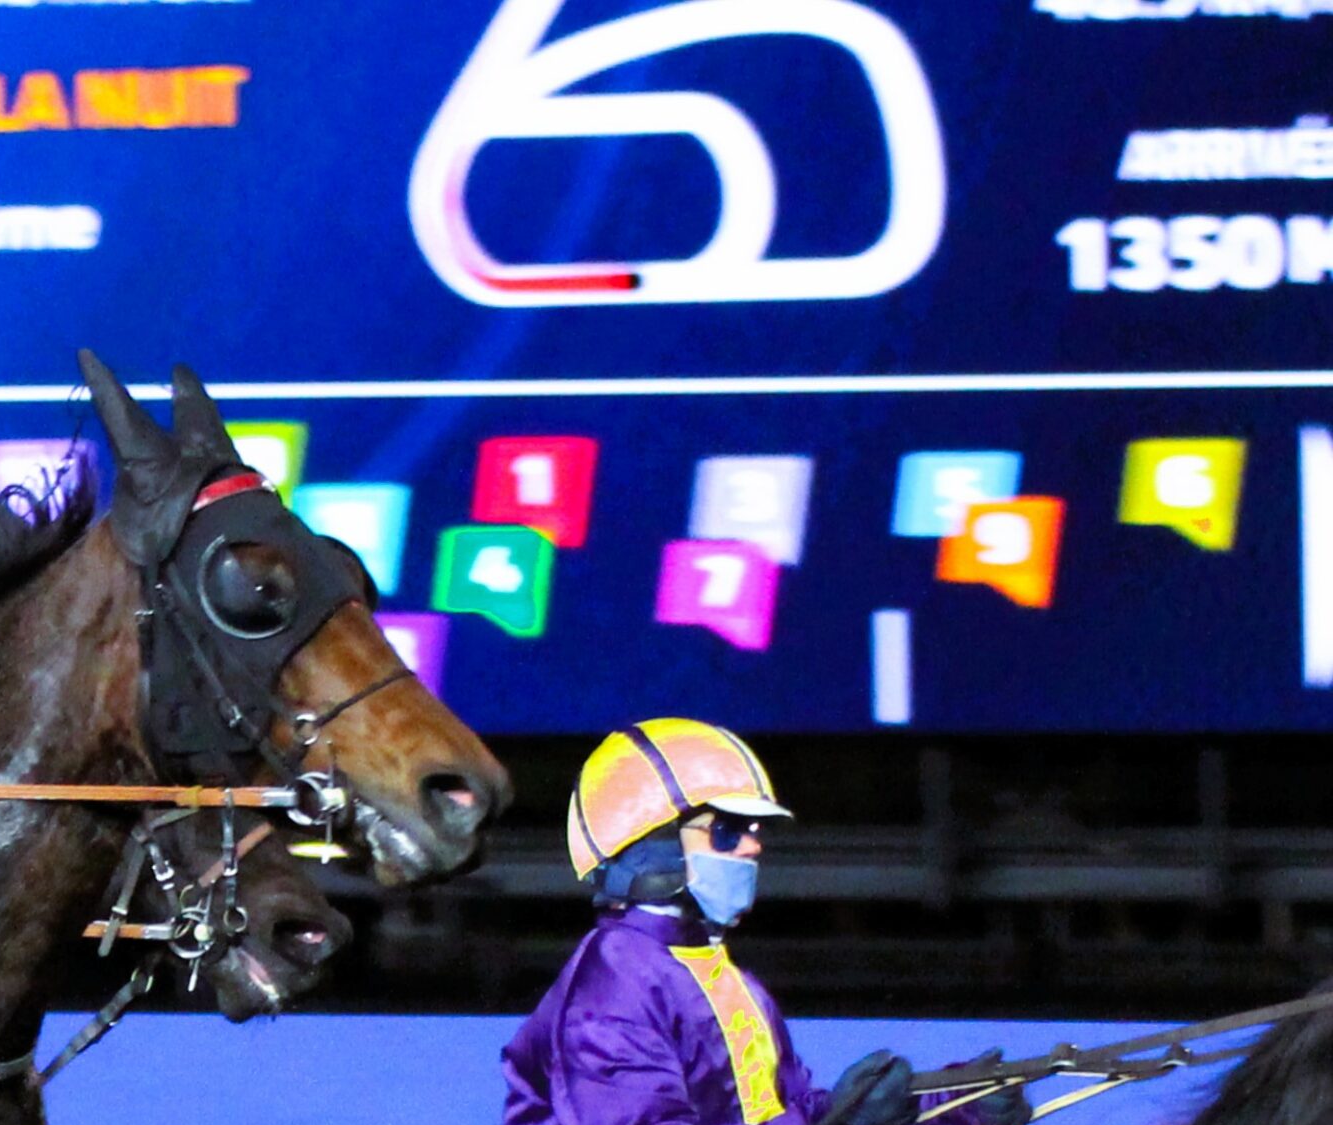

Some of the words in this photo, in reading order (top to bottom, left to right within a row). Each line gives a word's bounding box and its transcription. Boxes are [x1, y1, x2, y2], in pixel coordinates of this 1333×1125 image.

[73, 65, 251, 130] NUIT
[1116, 114, 1333, 181] ARRIVÉ
[510, 453, 554, 506] 1
[728, 469, 779, 523] 3
[1153, 454, 1214, 509] 6
[972, 511, 1031, 566] 9
[467, 545, 524, 594] 4
[691, 554, 746, 608] 7
